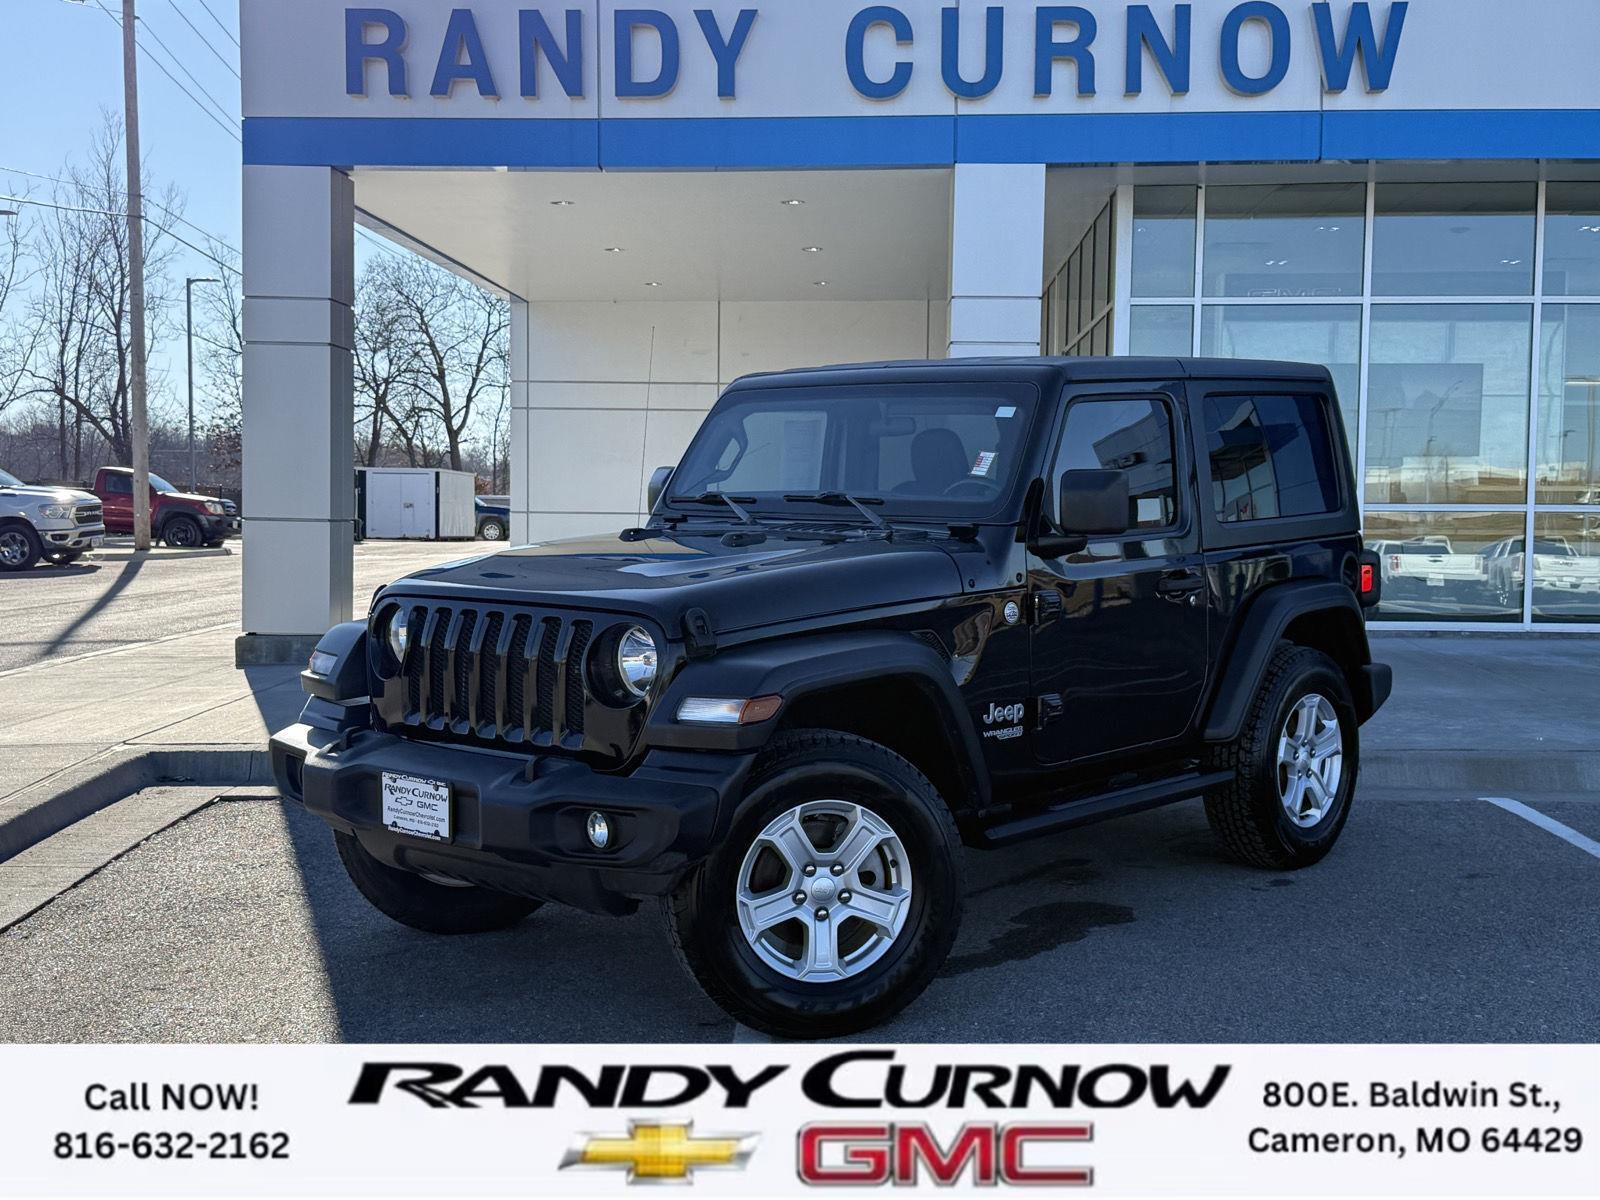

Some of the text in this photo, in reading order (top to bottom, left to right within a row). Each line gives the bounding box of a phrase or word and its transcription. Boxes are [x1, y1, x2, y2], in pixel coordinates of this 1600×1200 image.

[346, 1, 1408, 98] RANDY CURNOW
[983, 703, 1024, 724] Jeep
[983, 726, 1024, 738] WRANGLER
[385, 783, 447, 803] RANDY CURNOW
[417, 801, 438, 811] GMC
